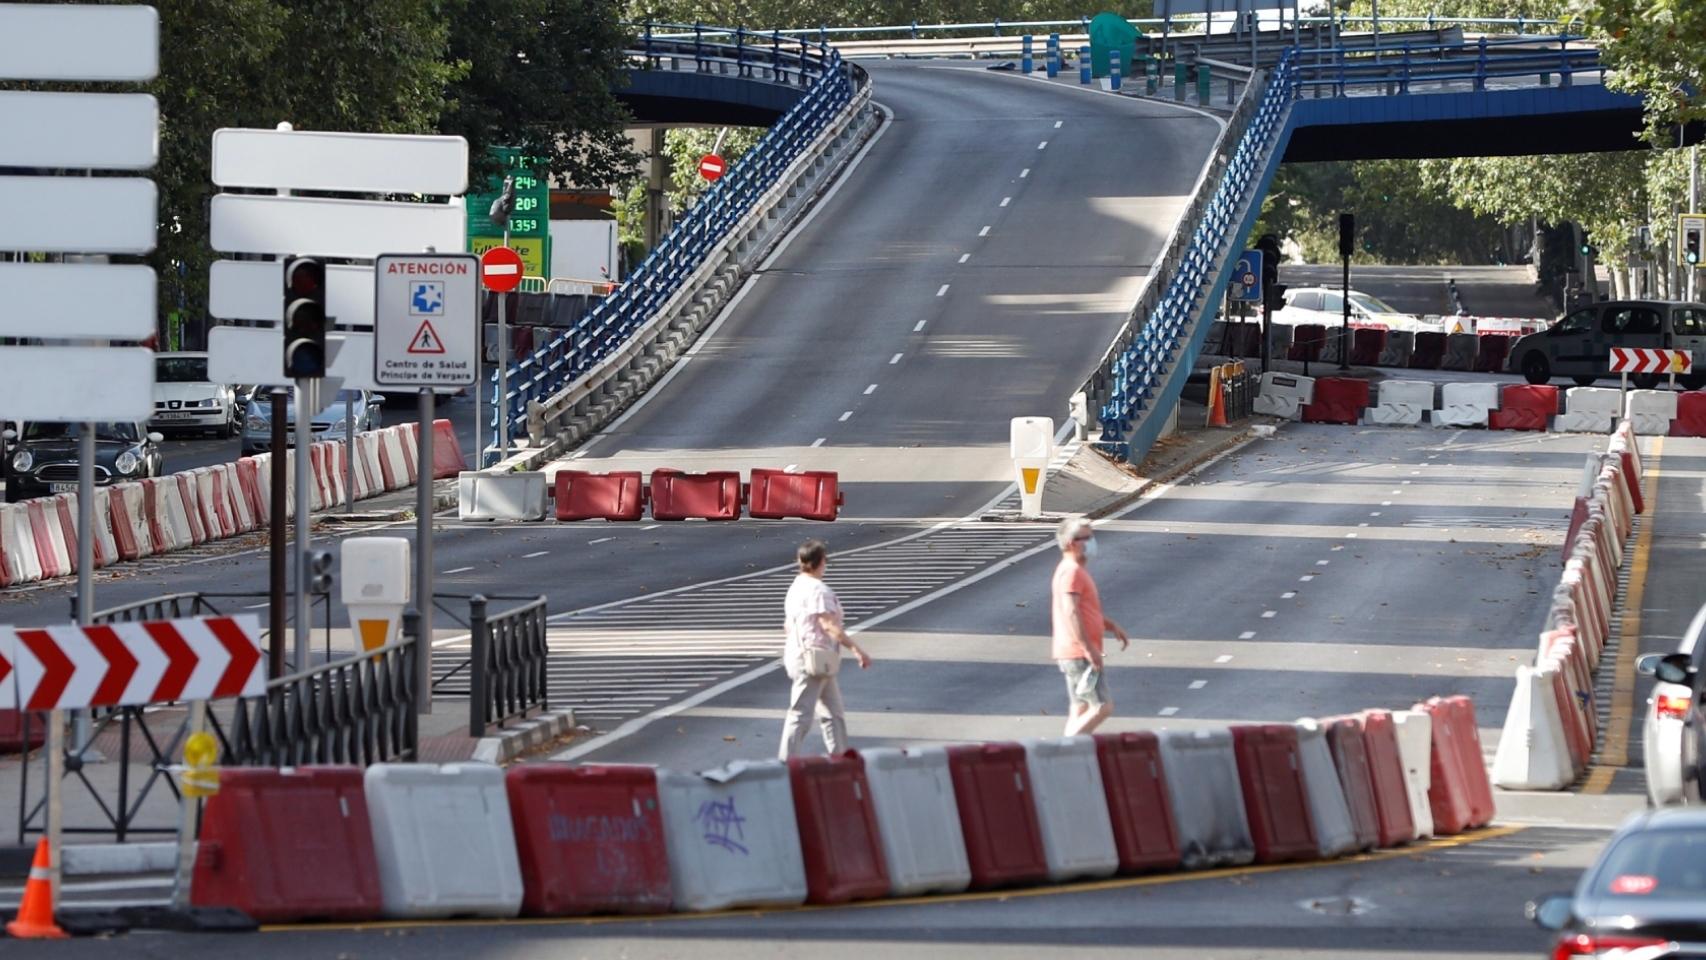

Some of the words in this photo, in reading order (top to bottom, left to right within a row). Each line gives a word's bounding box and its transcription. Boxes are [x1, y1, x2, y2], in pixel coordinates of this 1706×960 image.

[387, 262, 467, 274] ATENCIÓN
[385, 360, 418, 369] Centro
[422, 360, 434, 369] de
[439, 360, 467, 369] Salud
[421, 371, 433, 380] de
[436, 371, 471, 381] Vergara
